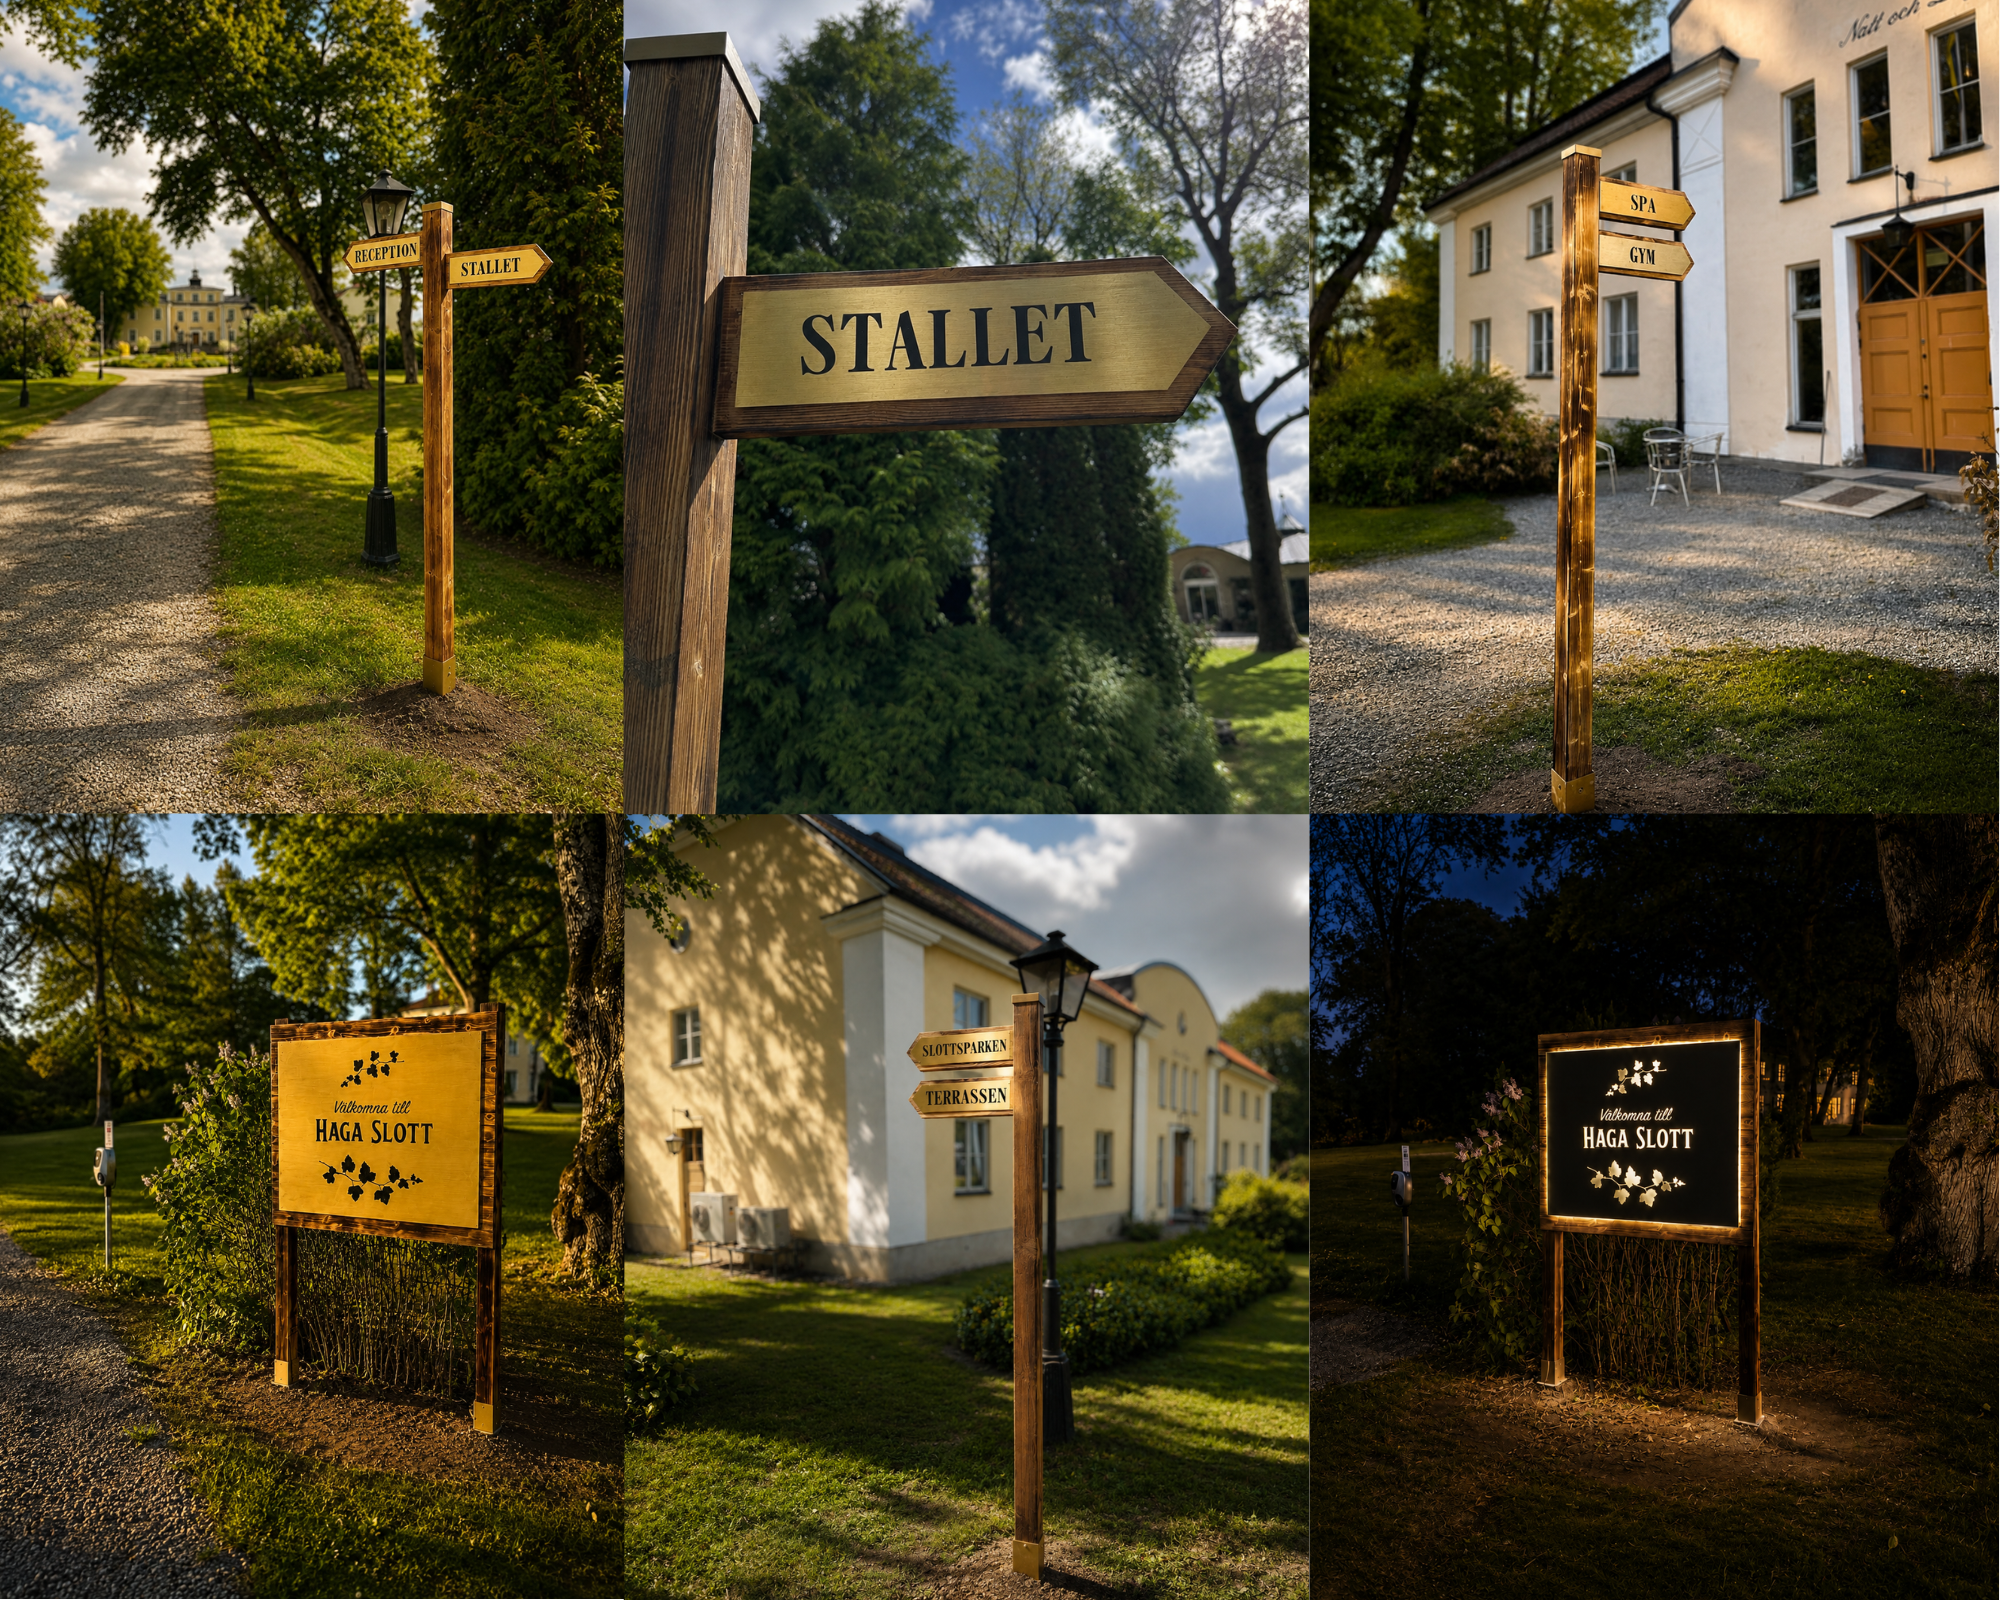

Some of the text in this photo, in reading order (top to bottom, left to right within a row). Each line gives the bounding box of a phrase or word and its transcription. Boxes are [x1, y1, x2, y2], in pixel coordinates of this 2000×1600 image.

[1838, 0, 1921, 48] Natt och
[1630, 194, 1656, 214] SPA
[355, 242, 417, 263] RECEPTION
[1629, 246, 1656, 265] GYM
[461, 257, 521, 277] STALLET
[801, 302, 1096, 375] STALLET
[922, 1039, 1007, 1057] SLOTTSPARKEN
[925, 1087, 1007, 1106] TERRASSEN
[334, 1100, 411, 1114] Välkomna till
[1600, 1107, 1673, 1121] Välkomna till
[316, 1118, 433, 1144] HAGA SLOTT
[1583, 1126, 1694, 1149] HAGA SLOTT
